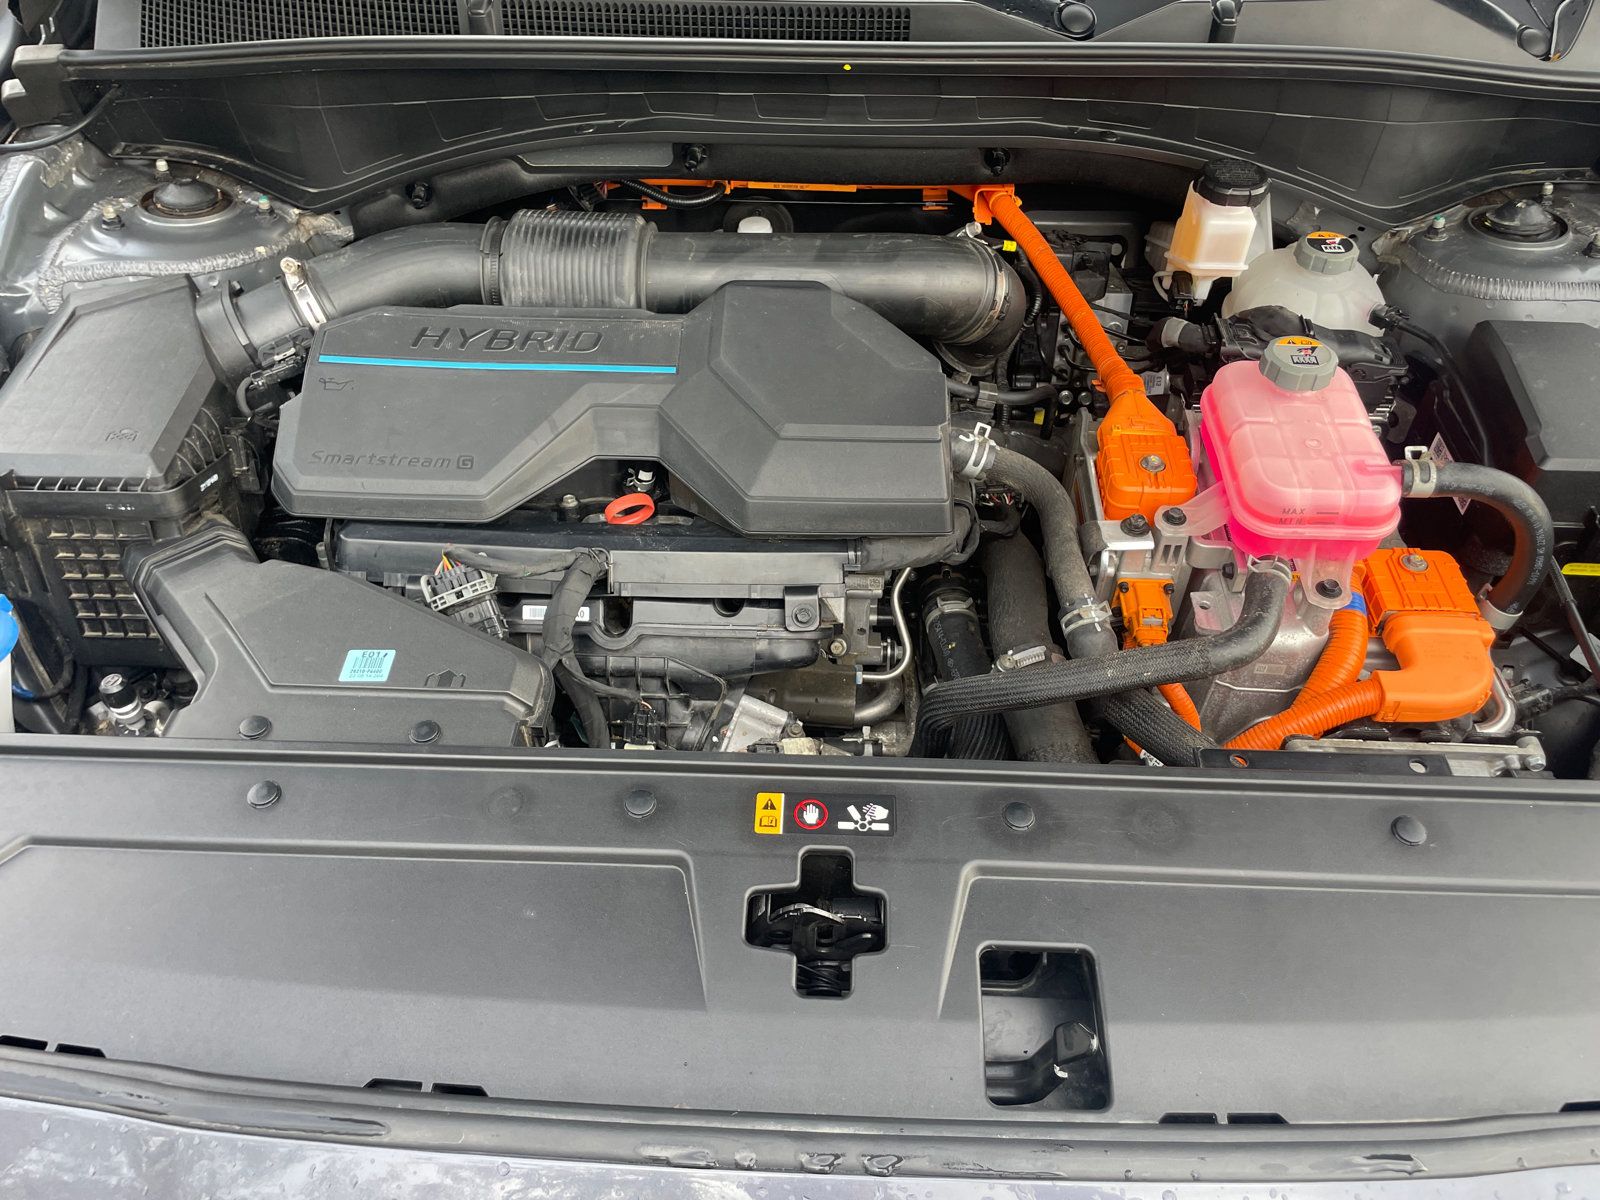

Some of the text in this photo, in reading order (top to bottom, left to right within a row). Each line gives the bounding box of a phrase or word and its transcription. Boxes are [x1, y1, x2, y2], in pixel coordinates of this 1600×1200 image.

[410, 326, 604, 353] HYBRID
[308, 450, 451, 469] Smartstream
[1282, 507, 1306, 515] MAX
